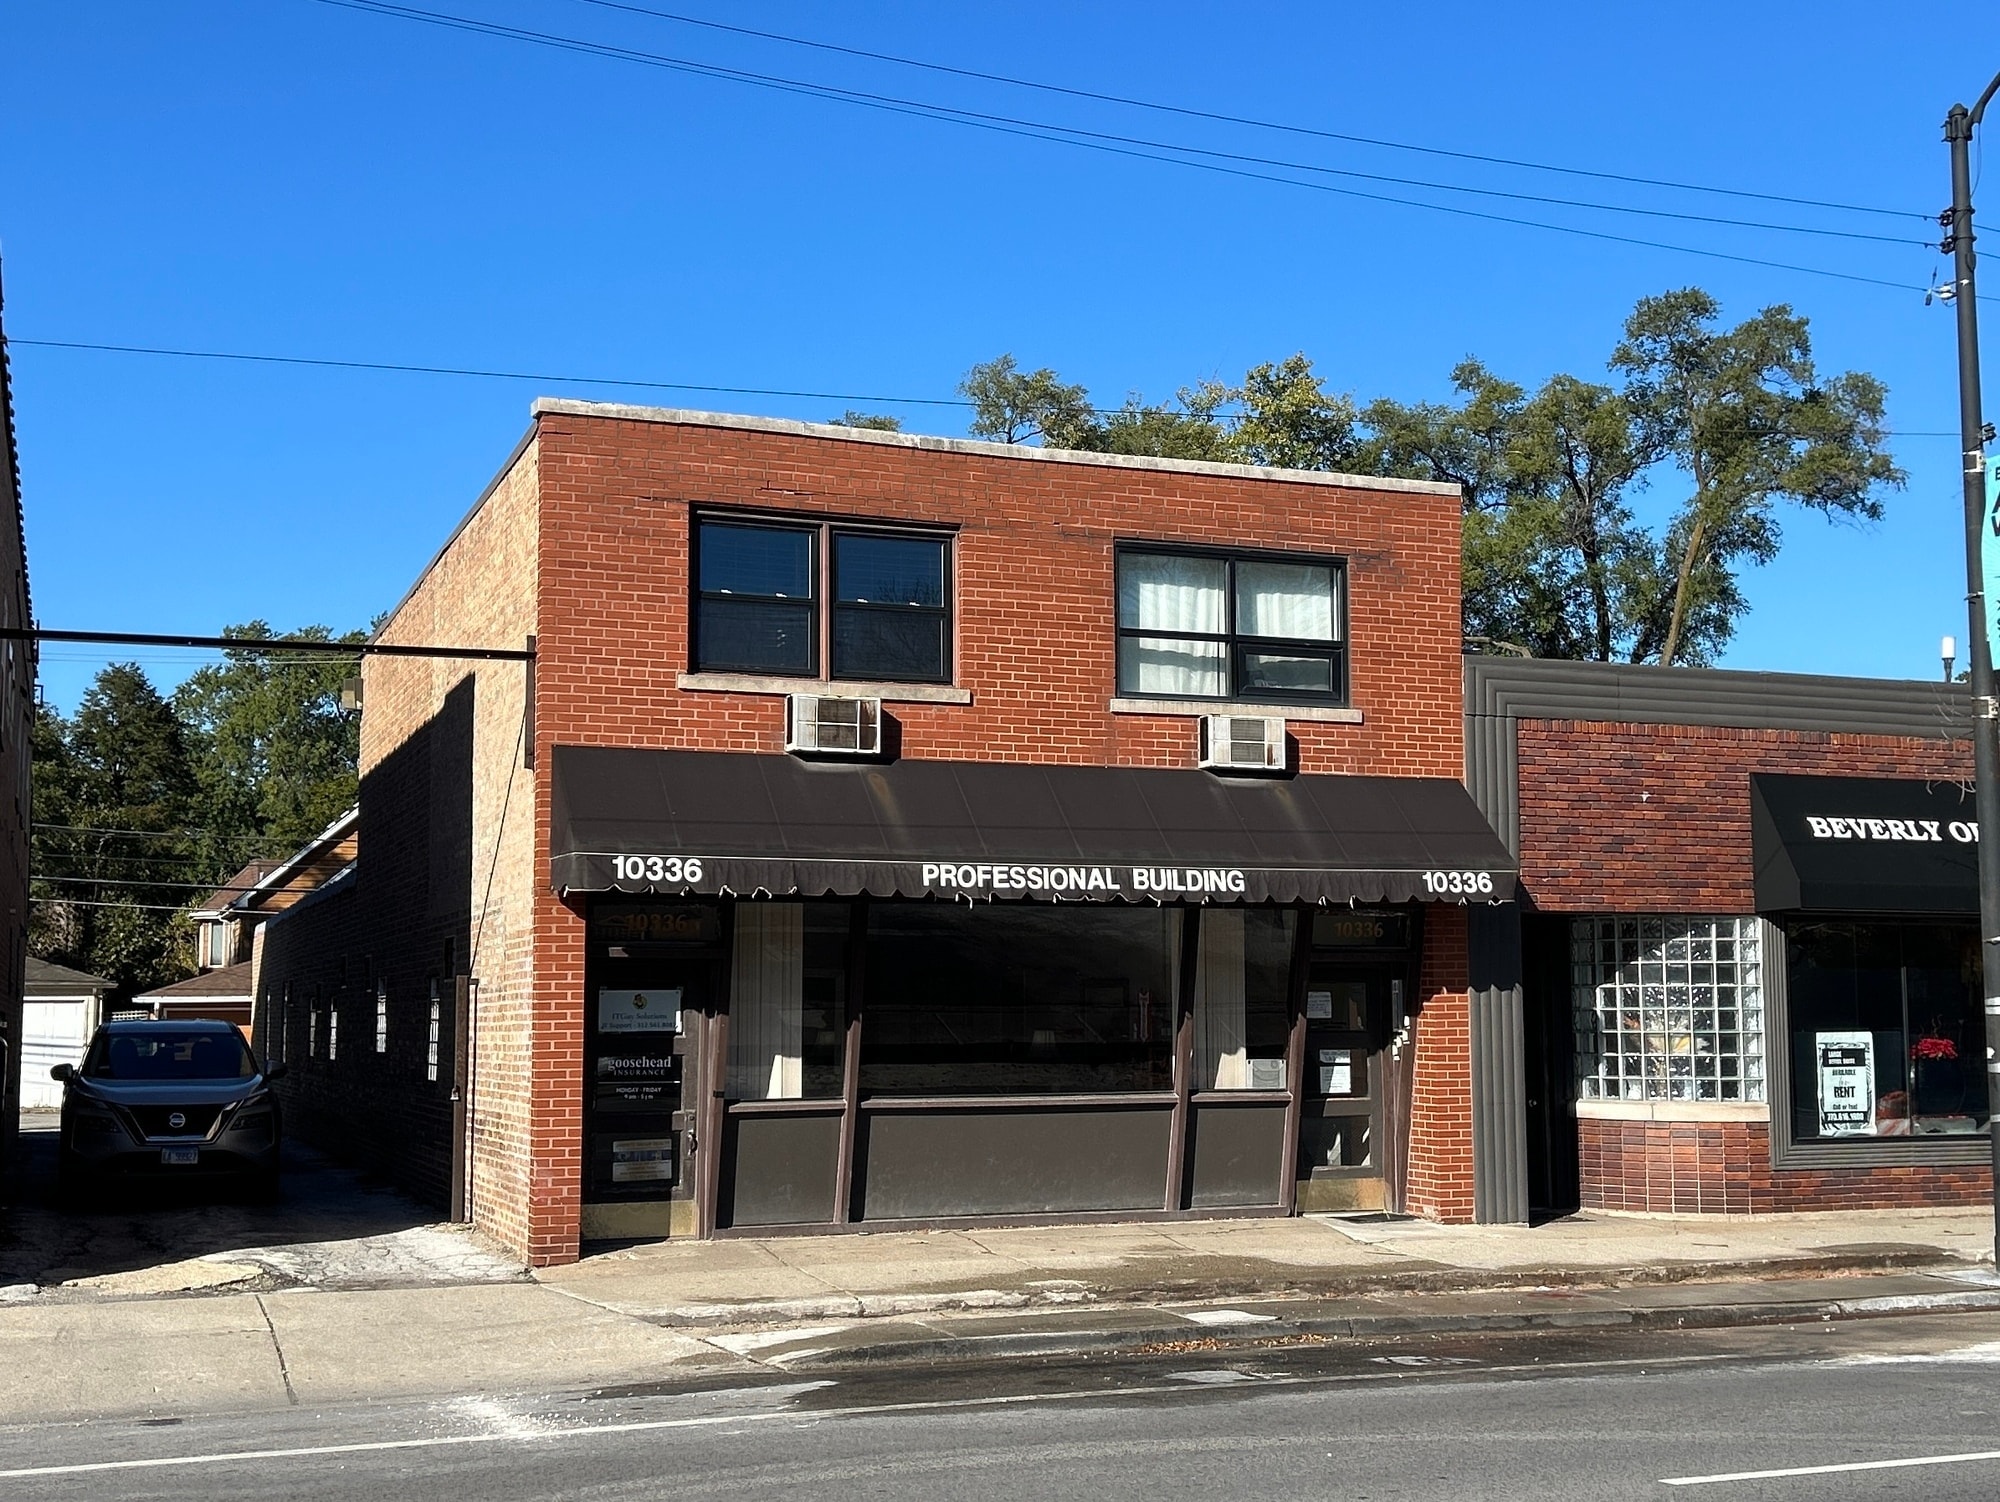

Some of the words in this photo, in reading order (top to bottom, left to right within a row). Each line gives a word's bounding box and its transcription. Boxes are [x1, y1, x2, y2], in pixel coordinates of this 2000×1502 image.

[1806, 816, 1943, 841] BEVERLY
[612, 855, 703, 883] 10336
[922, 864, 1121, 891] PROFESSIONAL
[1132, 867, 1246, 892] BUILDING
[1422, 871, 1493, 893] 10336
[1334, 921, 1384, 938] 10336
[608, 1055, 672, 1071] goosehead
[1833, 1086, 1856, 1098] RENT
